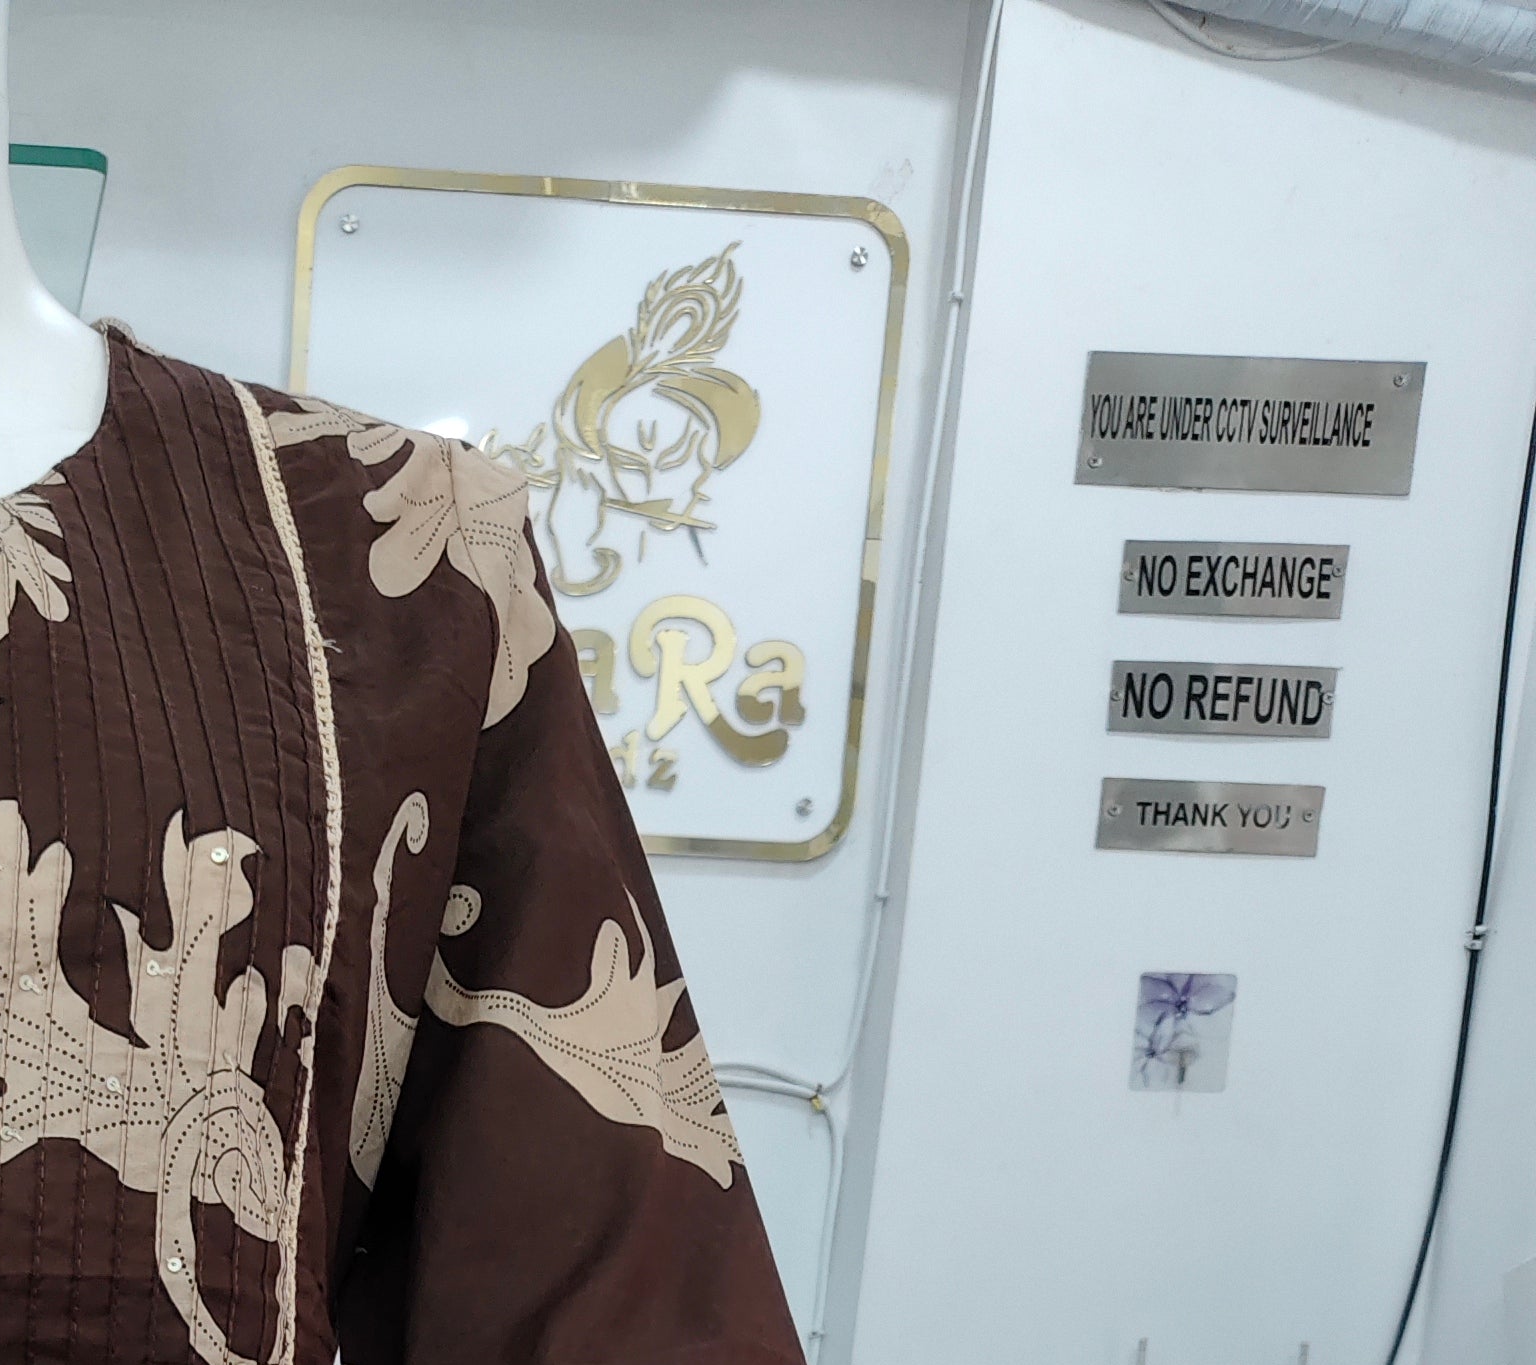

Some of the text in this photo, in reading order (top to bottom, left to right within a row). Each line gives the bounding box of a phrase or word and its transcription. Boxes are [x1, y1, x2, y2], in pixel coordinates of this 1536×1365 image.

[1090, 394, 1375, 448] YOU ARE UNDER CCTV SURVEILLANCE
[1137, 555, 1334, 600] NO EXCHANGE
[1121, 672, 1324, 726] NO REFUND
[1136, 801, 1292, 830] THANK YOU
